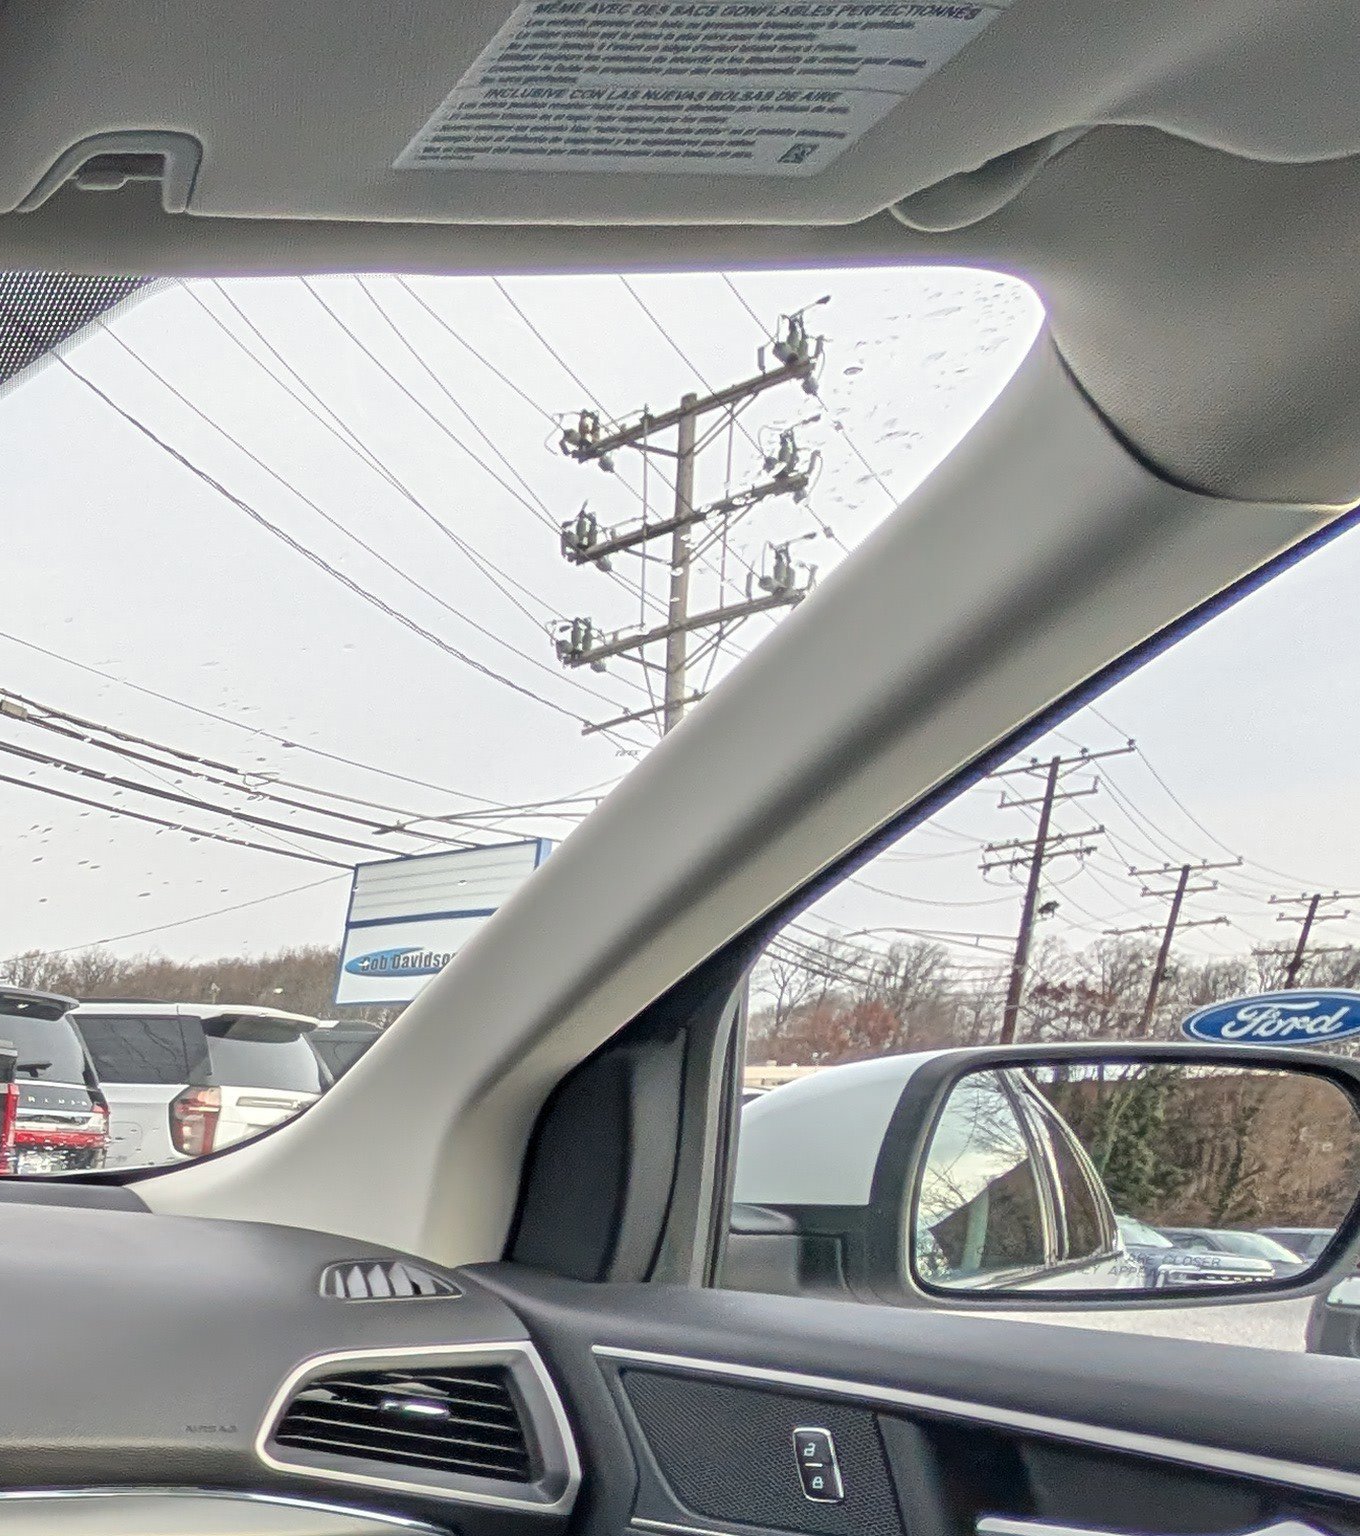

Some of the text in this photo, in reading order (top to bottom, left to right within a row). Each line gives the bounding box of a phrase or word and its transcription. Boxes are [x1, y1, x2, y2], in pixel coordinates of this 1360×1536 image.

[391, 951, 456, 969] Davidso
[1221, 1001, 1350, 1038] Ford
[1162, 1256, 1221, 1267] CLOSER
